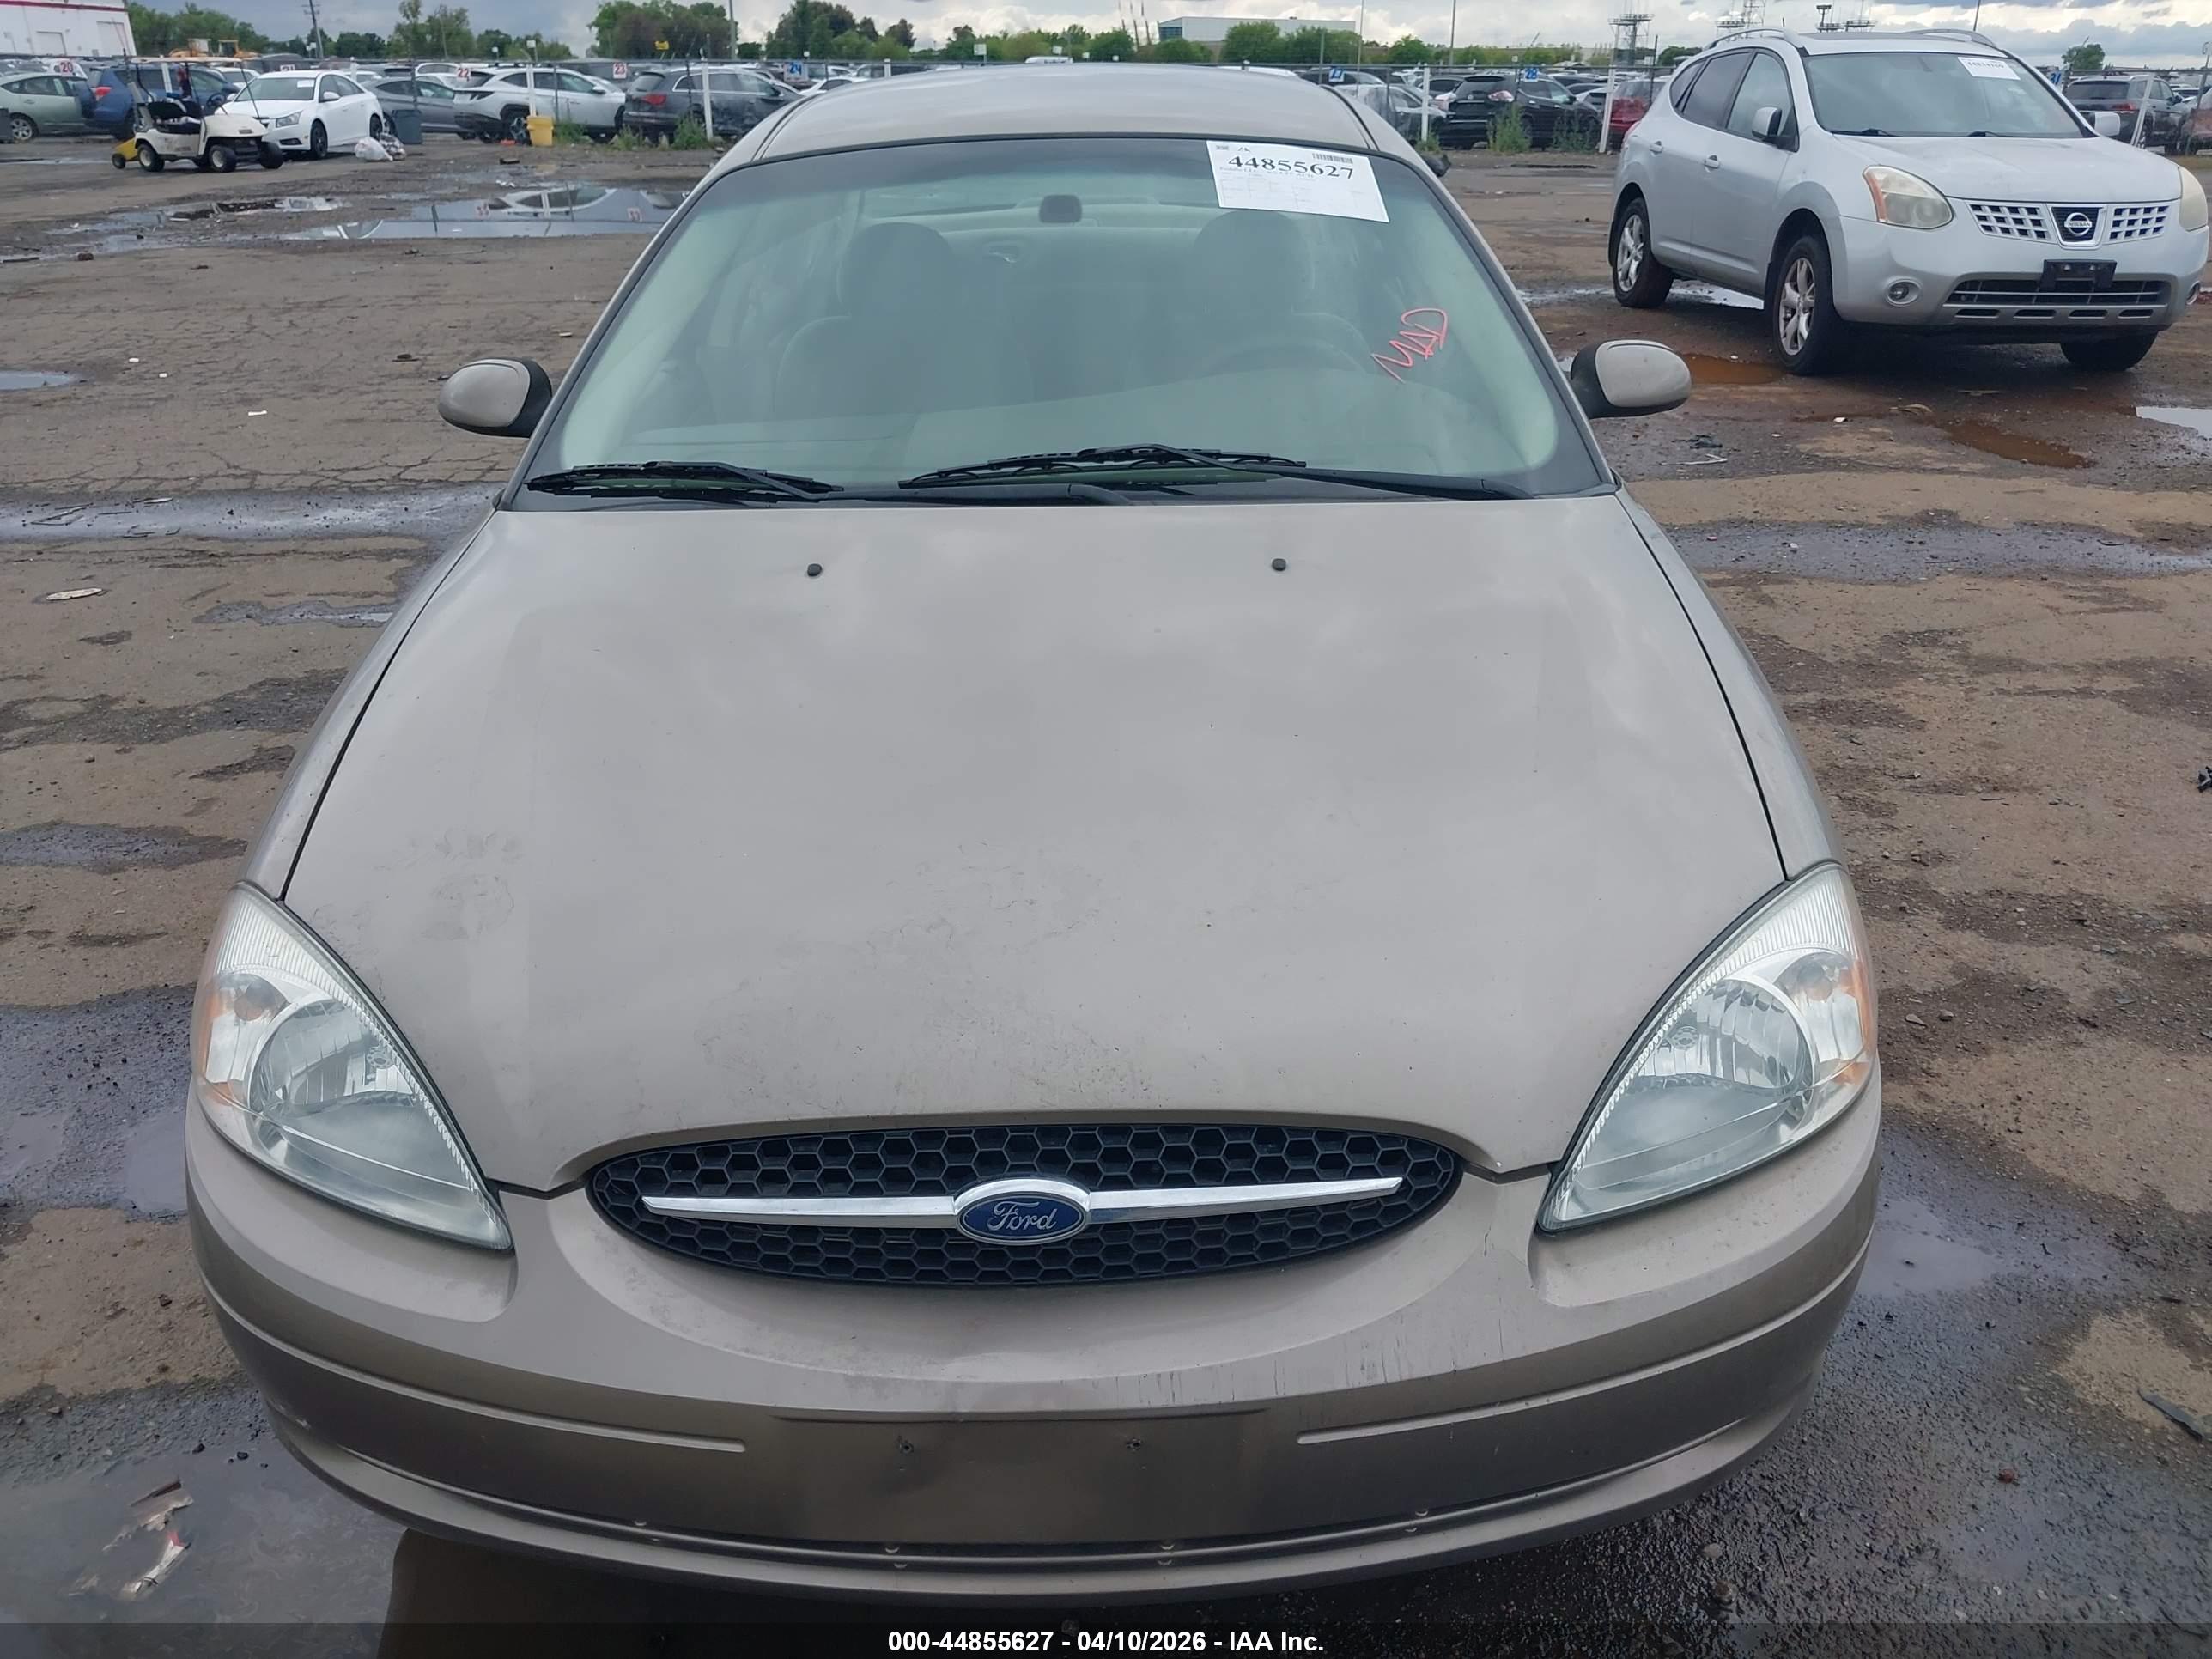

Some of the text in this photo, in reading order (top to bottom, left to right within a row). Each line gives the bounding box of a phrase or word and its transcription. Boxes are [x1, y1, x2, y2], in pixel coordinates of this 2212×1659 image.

[60, 61, 73, 73] 20
[457, 68, 469, 78] 22
[614, 62, 626, 75] 23
[789, 62, 802, 76] 24
[1525, 68, 1537, 80] 28
[1228, 155, 1354, 180] 44855627
[988, 1200, 1057, 1231] Ford
